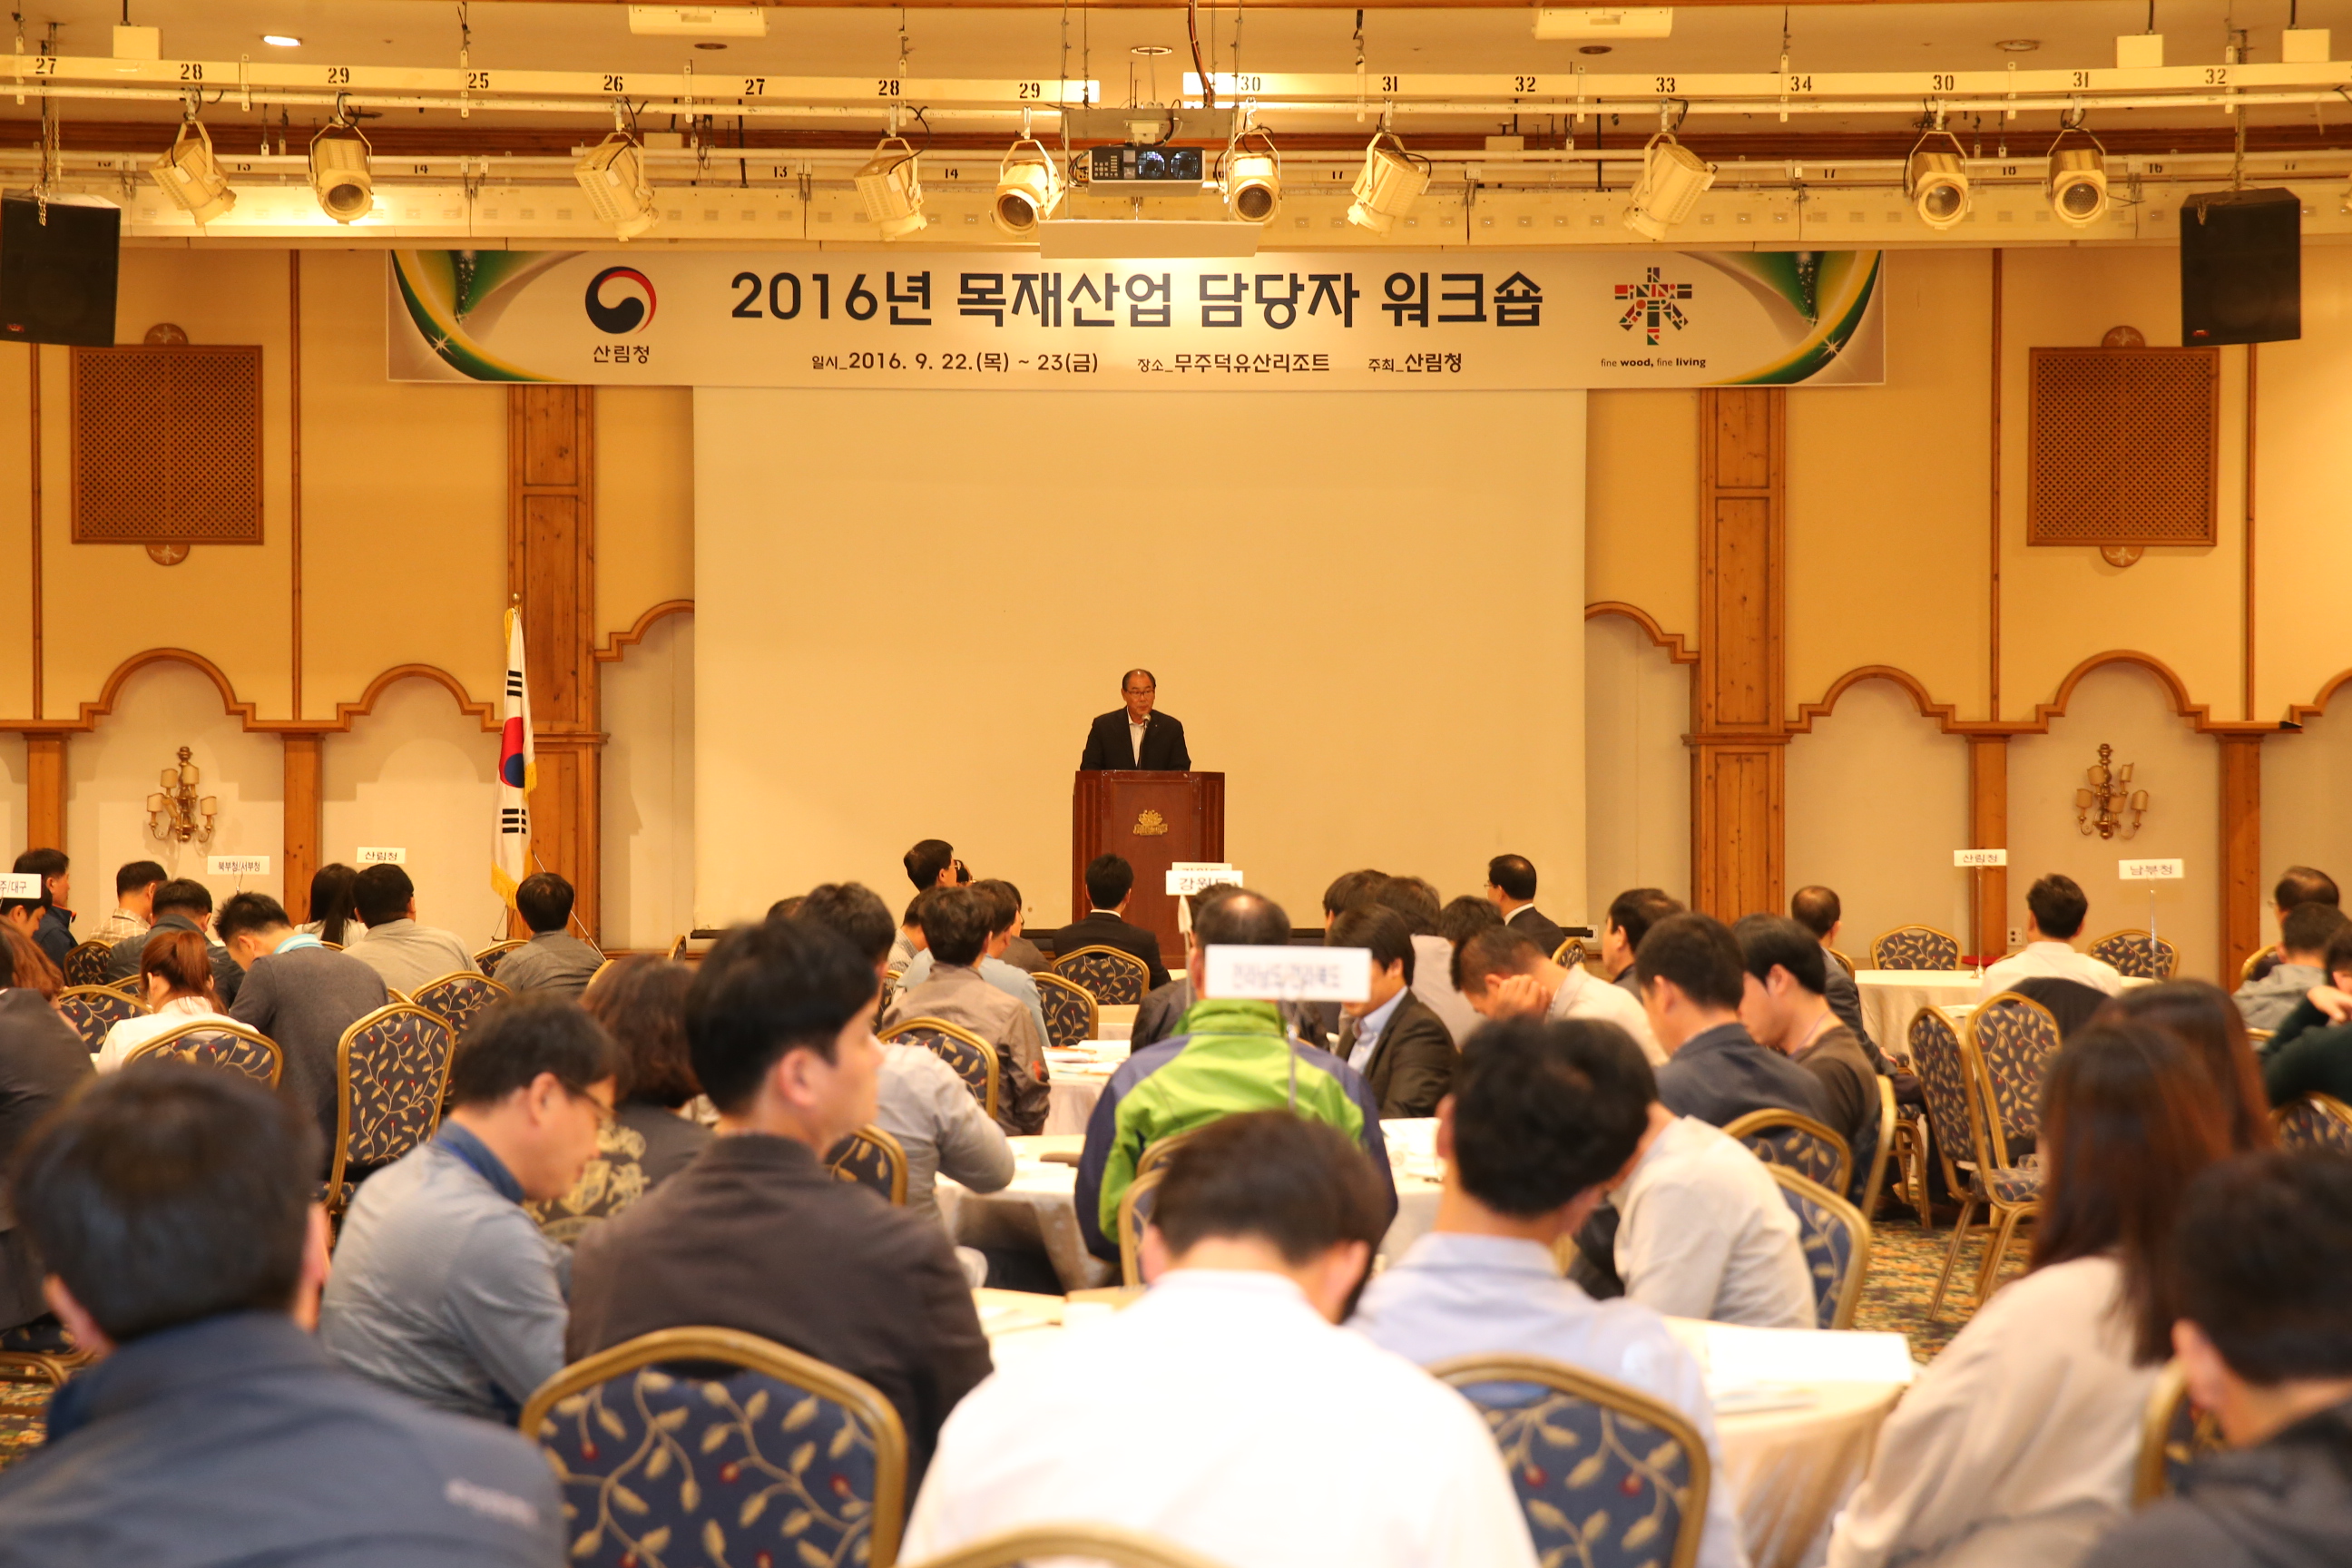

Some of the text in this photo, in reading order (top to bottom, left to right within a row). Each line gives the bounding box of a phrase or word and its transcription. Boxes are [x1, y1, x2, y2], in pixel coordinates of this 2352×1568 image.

[35, 57, 57, 75] 27
[180, 64, 203, 82] 28
[328, 67, 349, 84] 29
[467, 72, 490, 90] 25
[603, 74, 624, 92] 26
[1240, 75, 1261, 93] 30
[1382, 75, 1398, 93] 31
[1514, 75, 1536, 93] 32
[1656, 76, 1676, 93] 33
[1790, 75, 1812, 92] 34
[1933, 74, 1955, 92] 30
[2073, 71, 2090, 89] 31
[2205, 67, 2228, 85] 32
[745, 78, 766, 96] 27
[878, 80, 900, 97] 28
[1019, 83, 1041, 100] 29
[774, 166, 789, 179] 13
[945, 168, 960, 181] 14
[730, 270, 1544, 330] 2016년 목재산업 담당자 워크숍
[593, 345, 651, 365] 산림청
[811, 351, 906, 370] 일시_2016.
[915, 352, 933, 370] 9.
[941, 351, 1010, 373] 22.(목)
[1037, 353, 1099, 373] 23(금)
[1137, 353, 1330, 373] 장소_무주덕유산리조트
[1367, 352, 1463, 373] 주최_산림청
[1601, 358, 1706, 368] fine wood, fine living
[364, 849, 398, 862] 산림청
[1962, 853, 1998, 863] 산림청
[2130, 864, 2173, 876] 남부청
